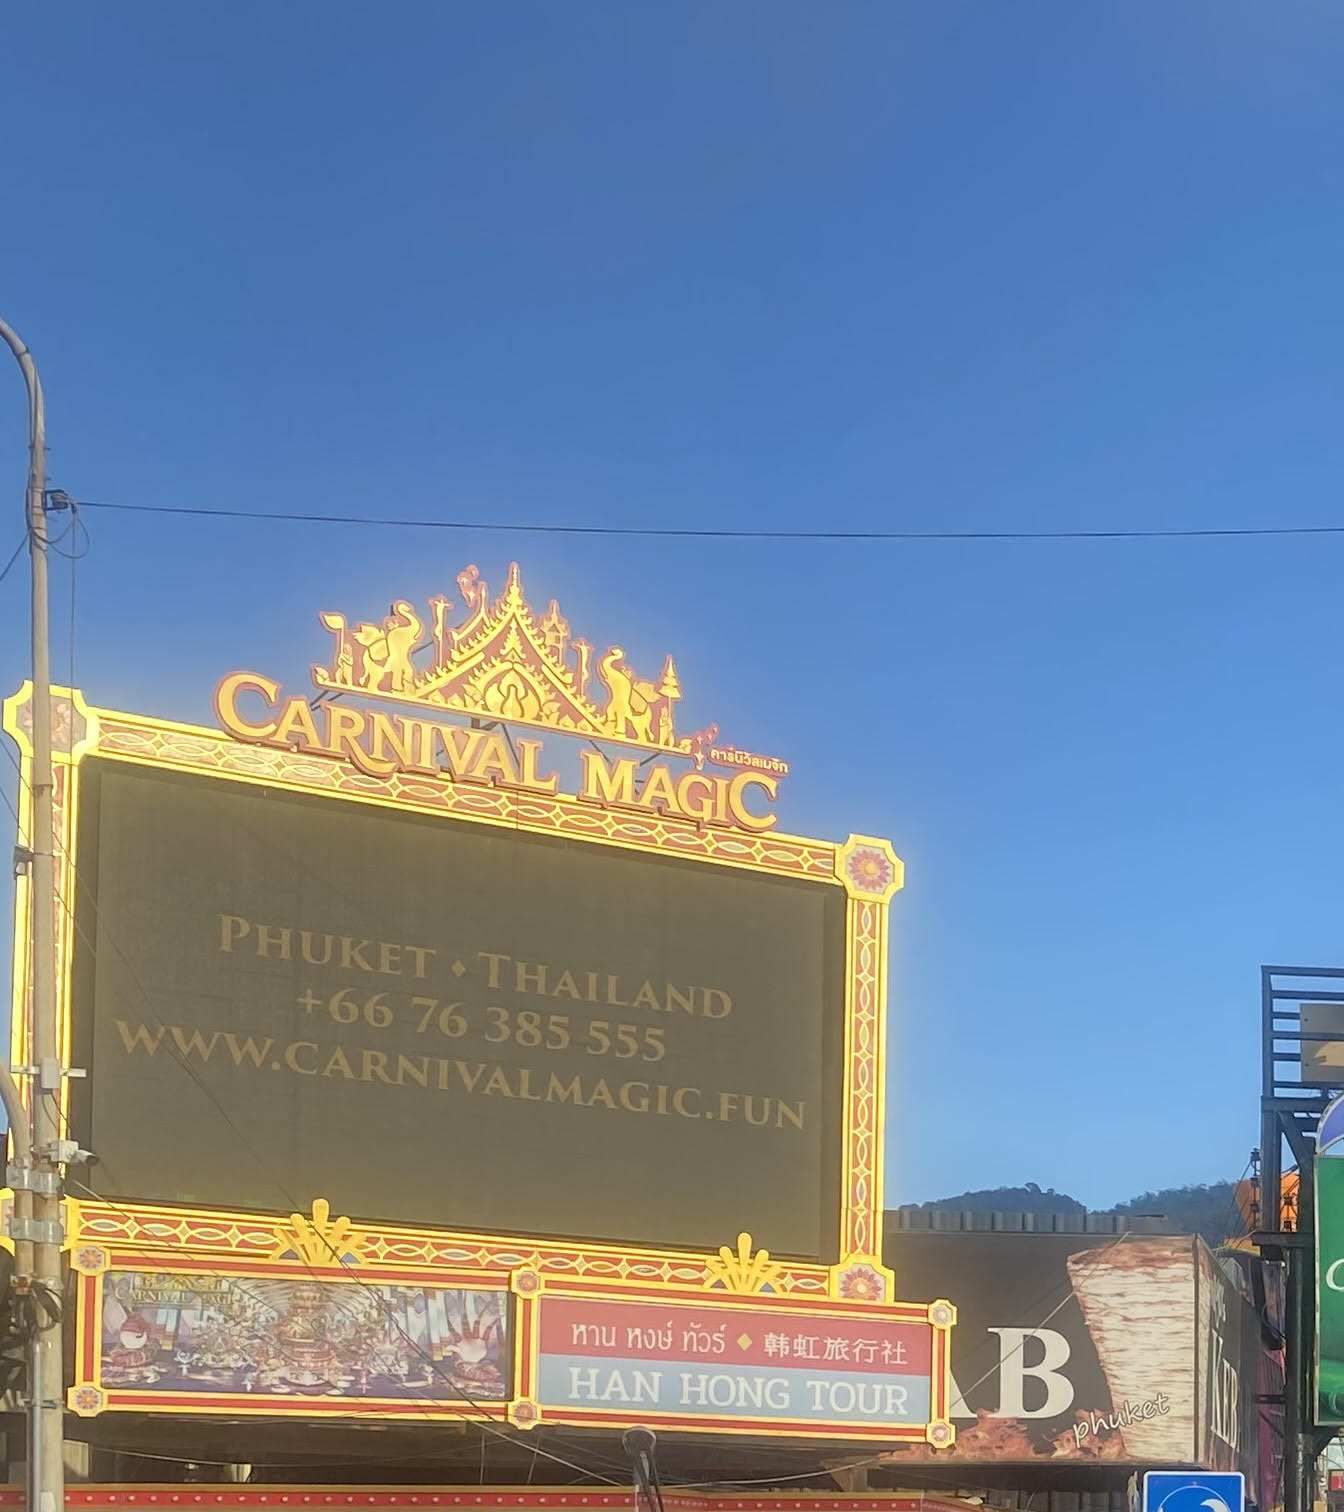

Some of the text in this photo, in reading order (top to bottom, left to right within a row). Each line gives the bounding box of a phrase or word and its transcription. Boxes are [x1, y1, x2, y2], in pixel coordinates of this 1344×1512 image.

[215, 671, 779, 832] CARNIVAL MAGIC
[217, 913, 734, 1020] PHUKET THAILAND
[297, 986, 666, 1063] +66 76 385 555
[112, 1017, 807, 1130] WWW.CARNIVALMAGIC.FUN
[682, 1321, 728, 1354] ทัวร์
[763, 1331, 909, 1365] 韩虹旅行社
[568, 1366, 909, 1416] HAN HONG TOUR
[1073, 1392, 1171, 1449] phuket
